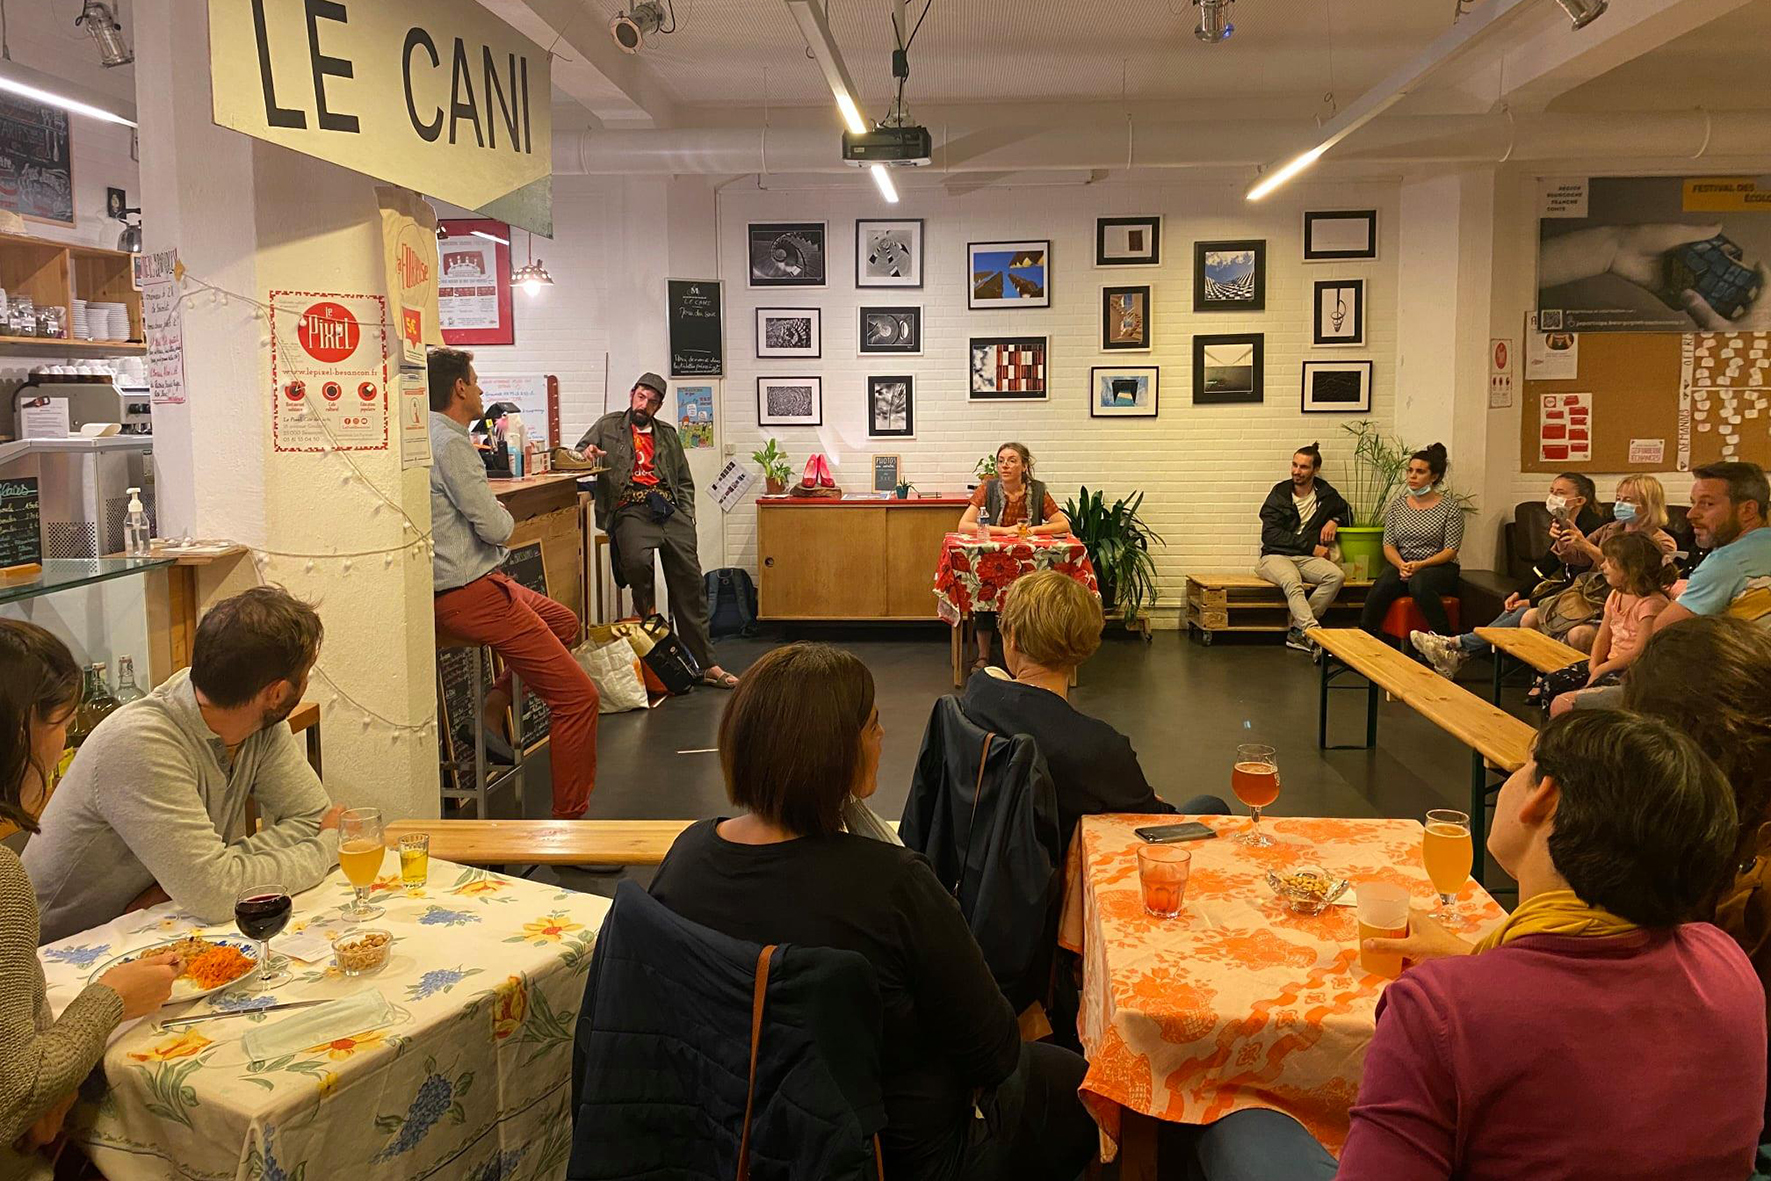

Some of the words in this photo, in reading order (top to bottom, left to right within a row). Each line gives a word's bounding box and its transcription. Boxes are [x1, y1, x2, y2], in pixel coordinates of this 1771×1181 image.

[252, 0, 360, 133] LE
[402, 27, 531, 154] CANI
[1692, 184, 1735, 192] FESTIVAL
[1737, 183, 1755, 192] DES
